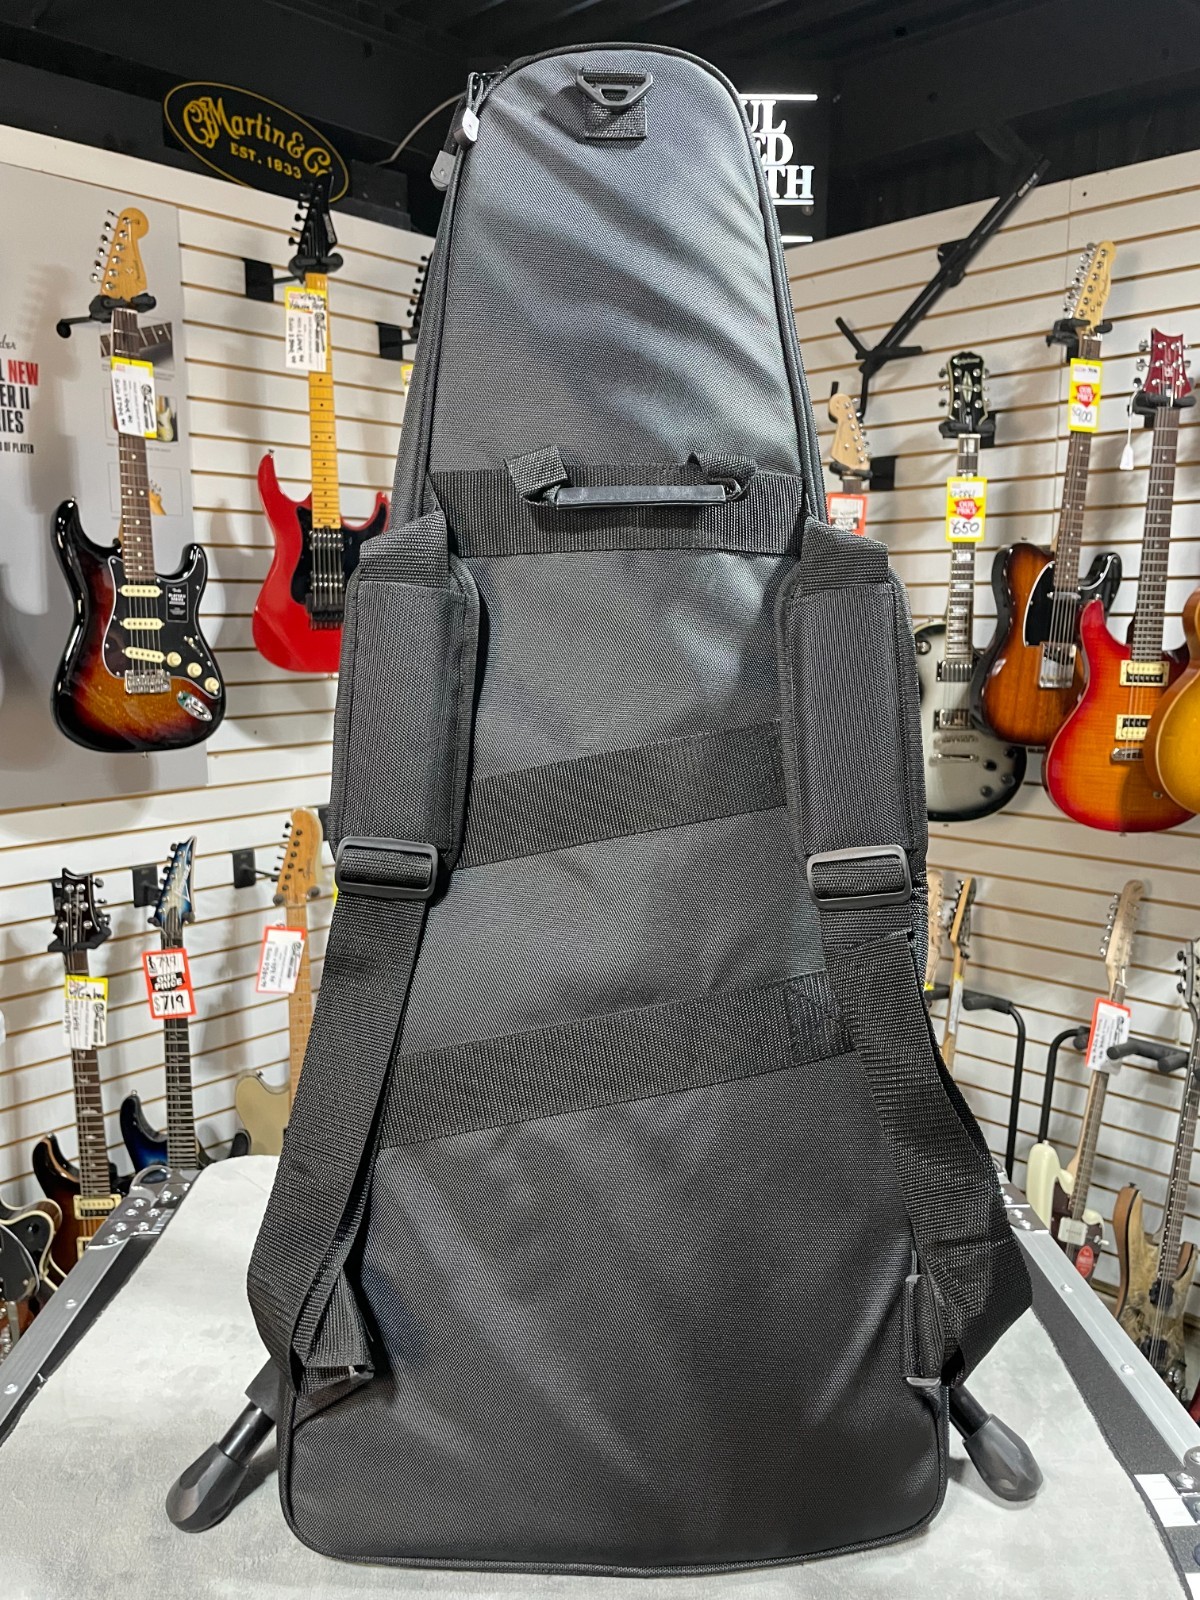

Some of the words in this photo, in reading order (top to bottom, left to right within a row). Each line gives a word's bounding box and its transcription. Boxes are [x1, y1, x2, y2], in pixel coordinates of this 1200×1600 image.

[266, 157, 302, 179] 1833
[8, 359, 39, 386] NEW
[0, 409, 24, 434] IES
[12, 442, 34, 454] PLAYER
[154, 978, 183, 991] PRICE
[156, 972, 177, 983] OUR
